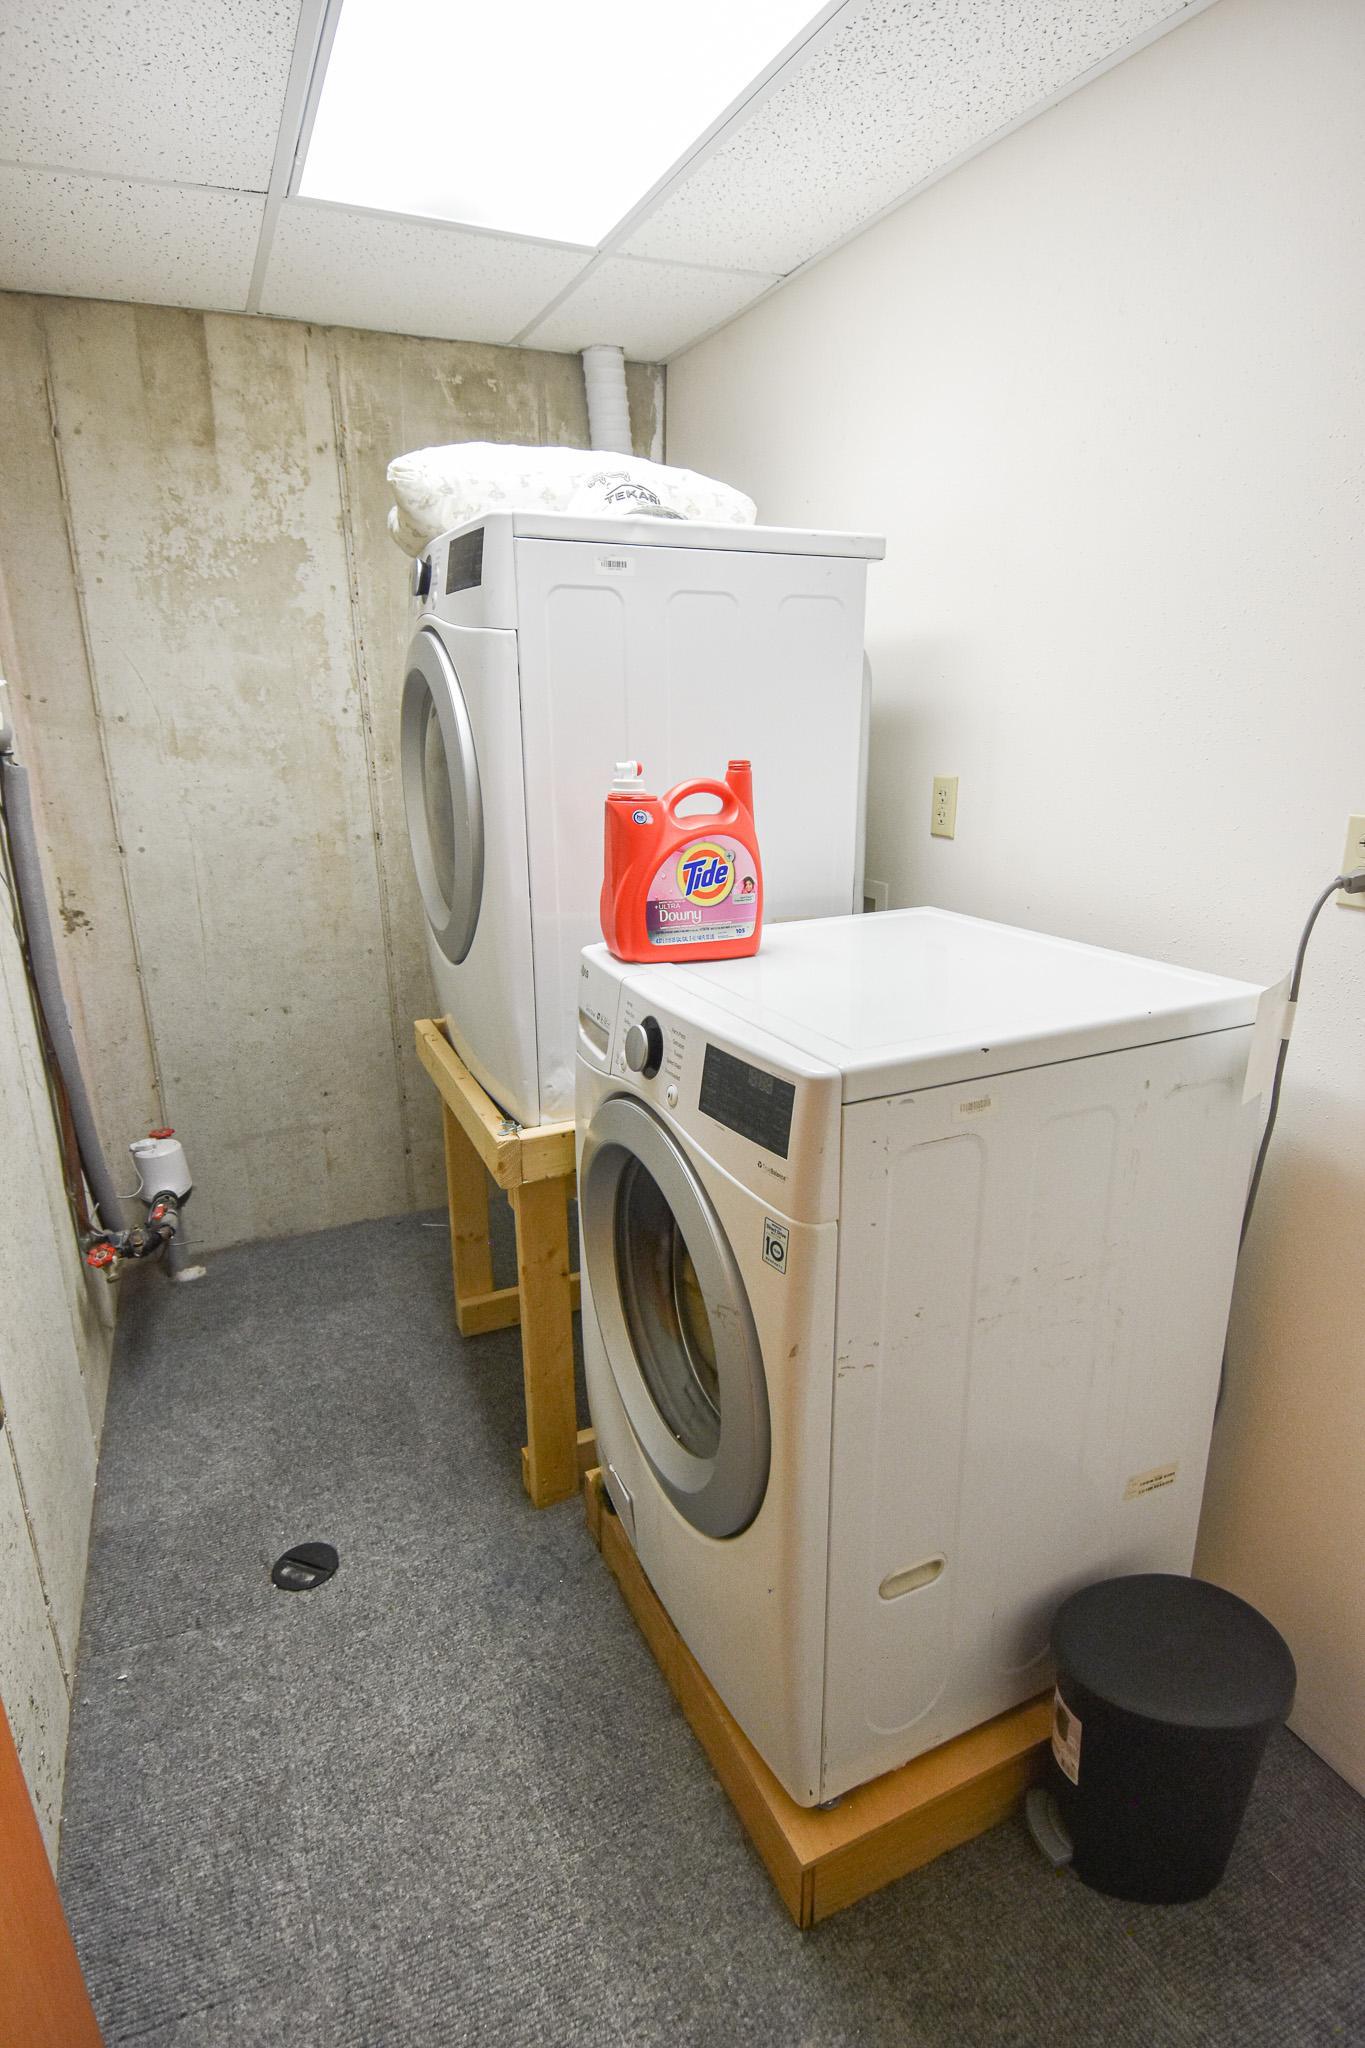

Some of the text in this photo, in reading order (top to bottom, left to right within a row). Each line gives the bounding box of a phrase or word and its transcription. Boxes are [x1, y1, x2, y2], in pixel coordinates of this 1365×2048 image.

[682, 857, 729, 897] Tide
[659, 910, 702, 925] Downy
[765, 1235, 785, 1263] 10
